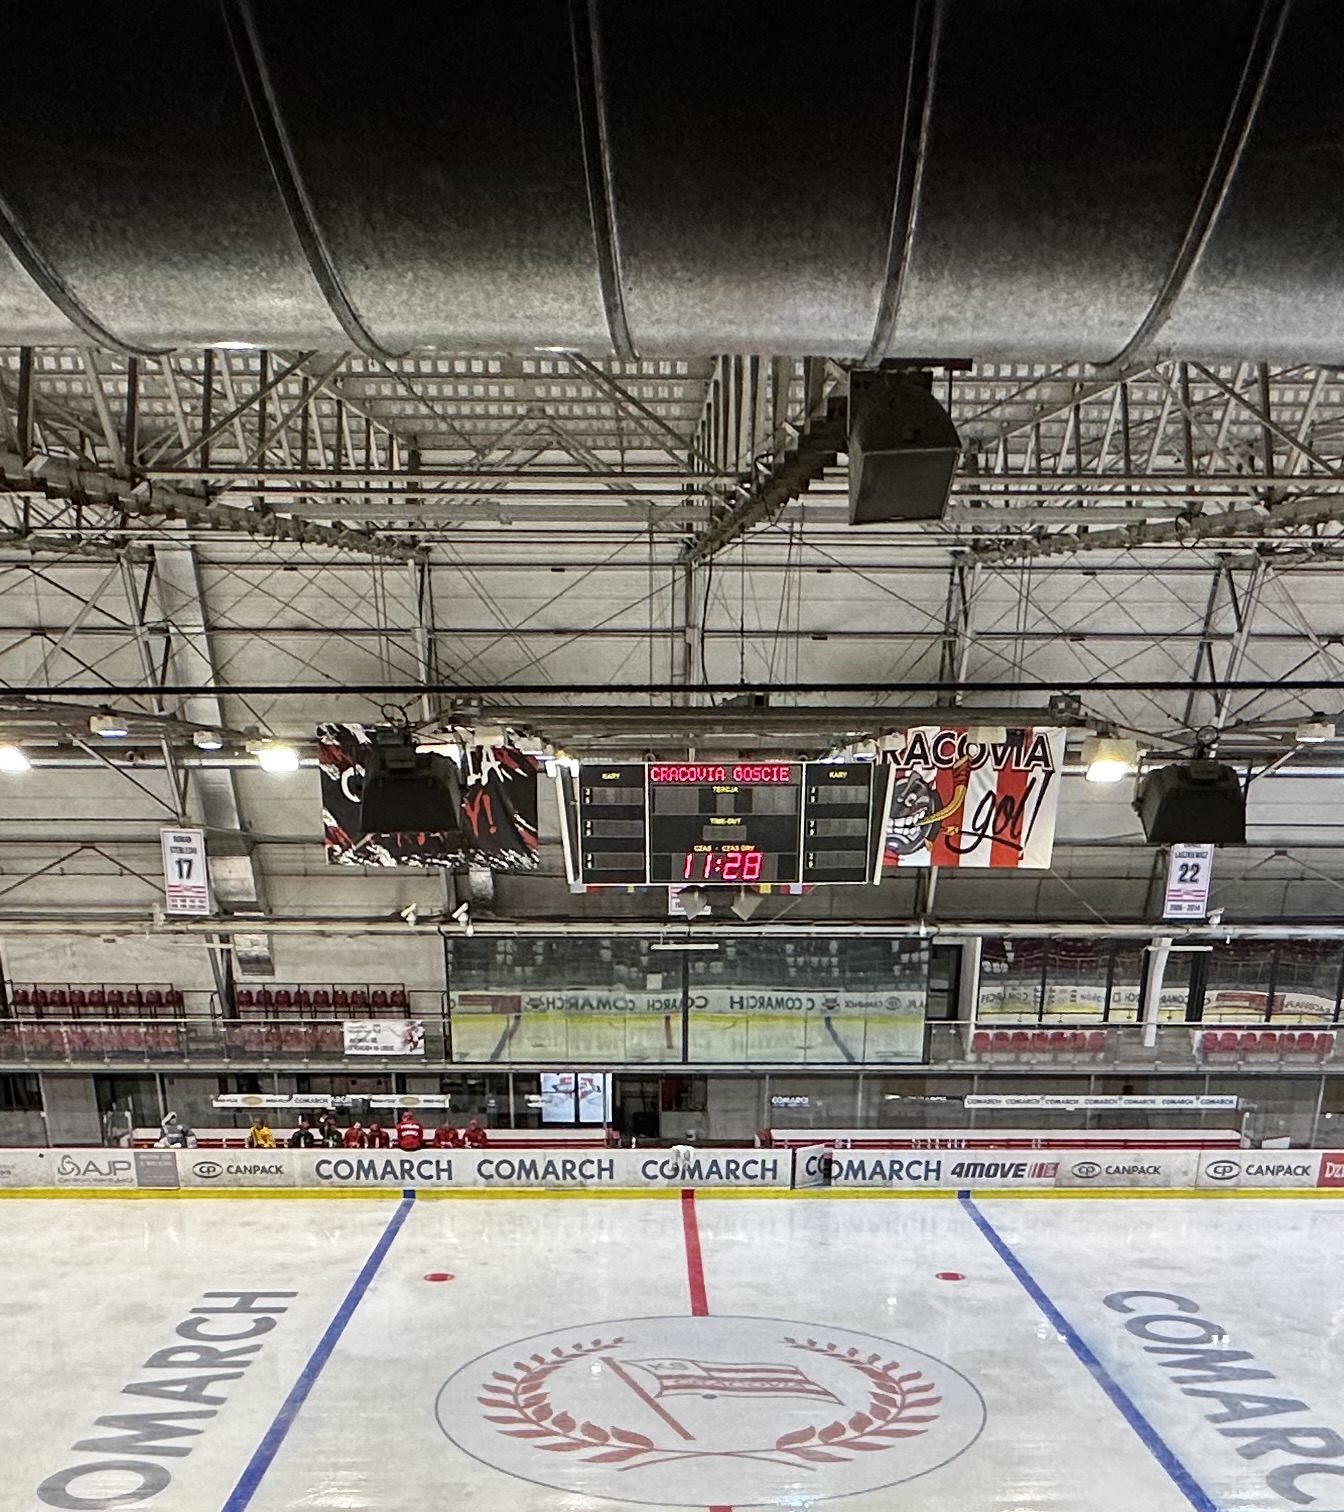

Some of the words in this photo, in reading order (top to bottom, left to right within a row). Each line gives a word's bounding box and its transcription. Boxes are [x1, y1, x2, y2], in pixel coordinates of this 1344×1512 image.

[650, 767, 726, 781] CRACOVIA
[733, 767, 790, 781] GOSCIE
[175, 858, 193, 879] 17
[684, 852, 763, 880] 11:28
[1178, 862, 1200, 884] 22
[82, 1160, 131, 1177] AJP
[226, 1164, 284, 1175] CANPACK
[315, 1159, 453, 1181] COMARCH
[476, 1158, 614, 1180] COMARCH
[641, 1158, 778, 1181] COMARCH
[950, 1162, 1028, 1178] 4MOVE
[1106, 1165, 1162, 1175] CANPACK
[1246, 1164, 1312, 1176] CANPACK
